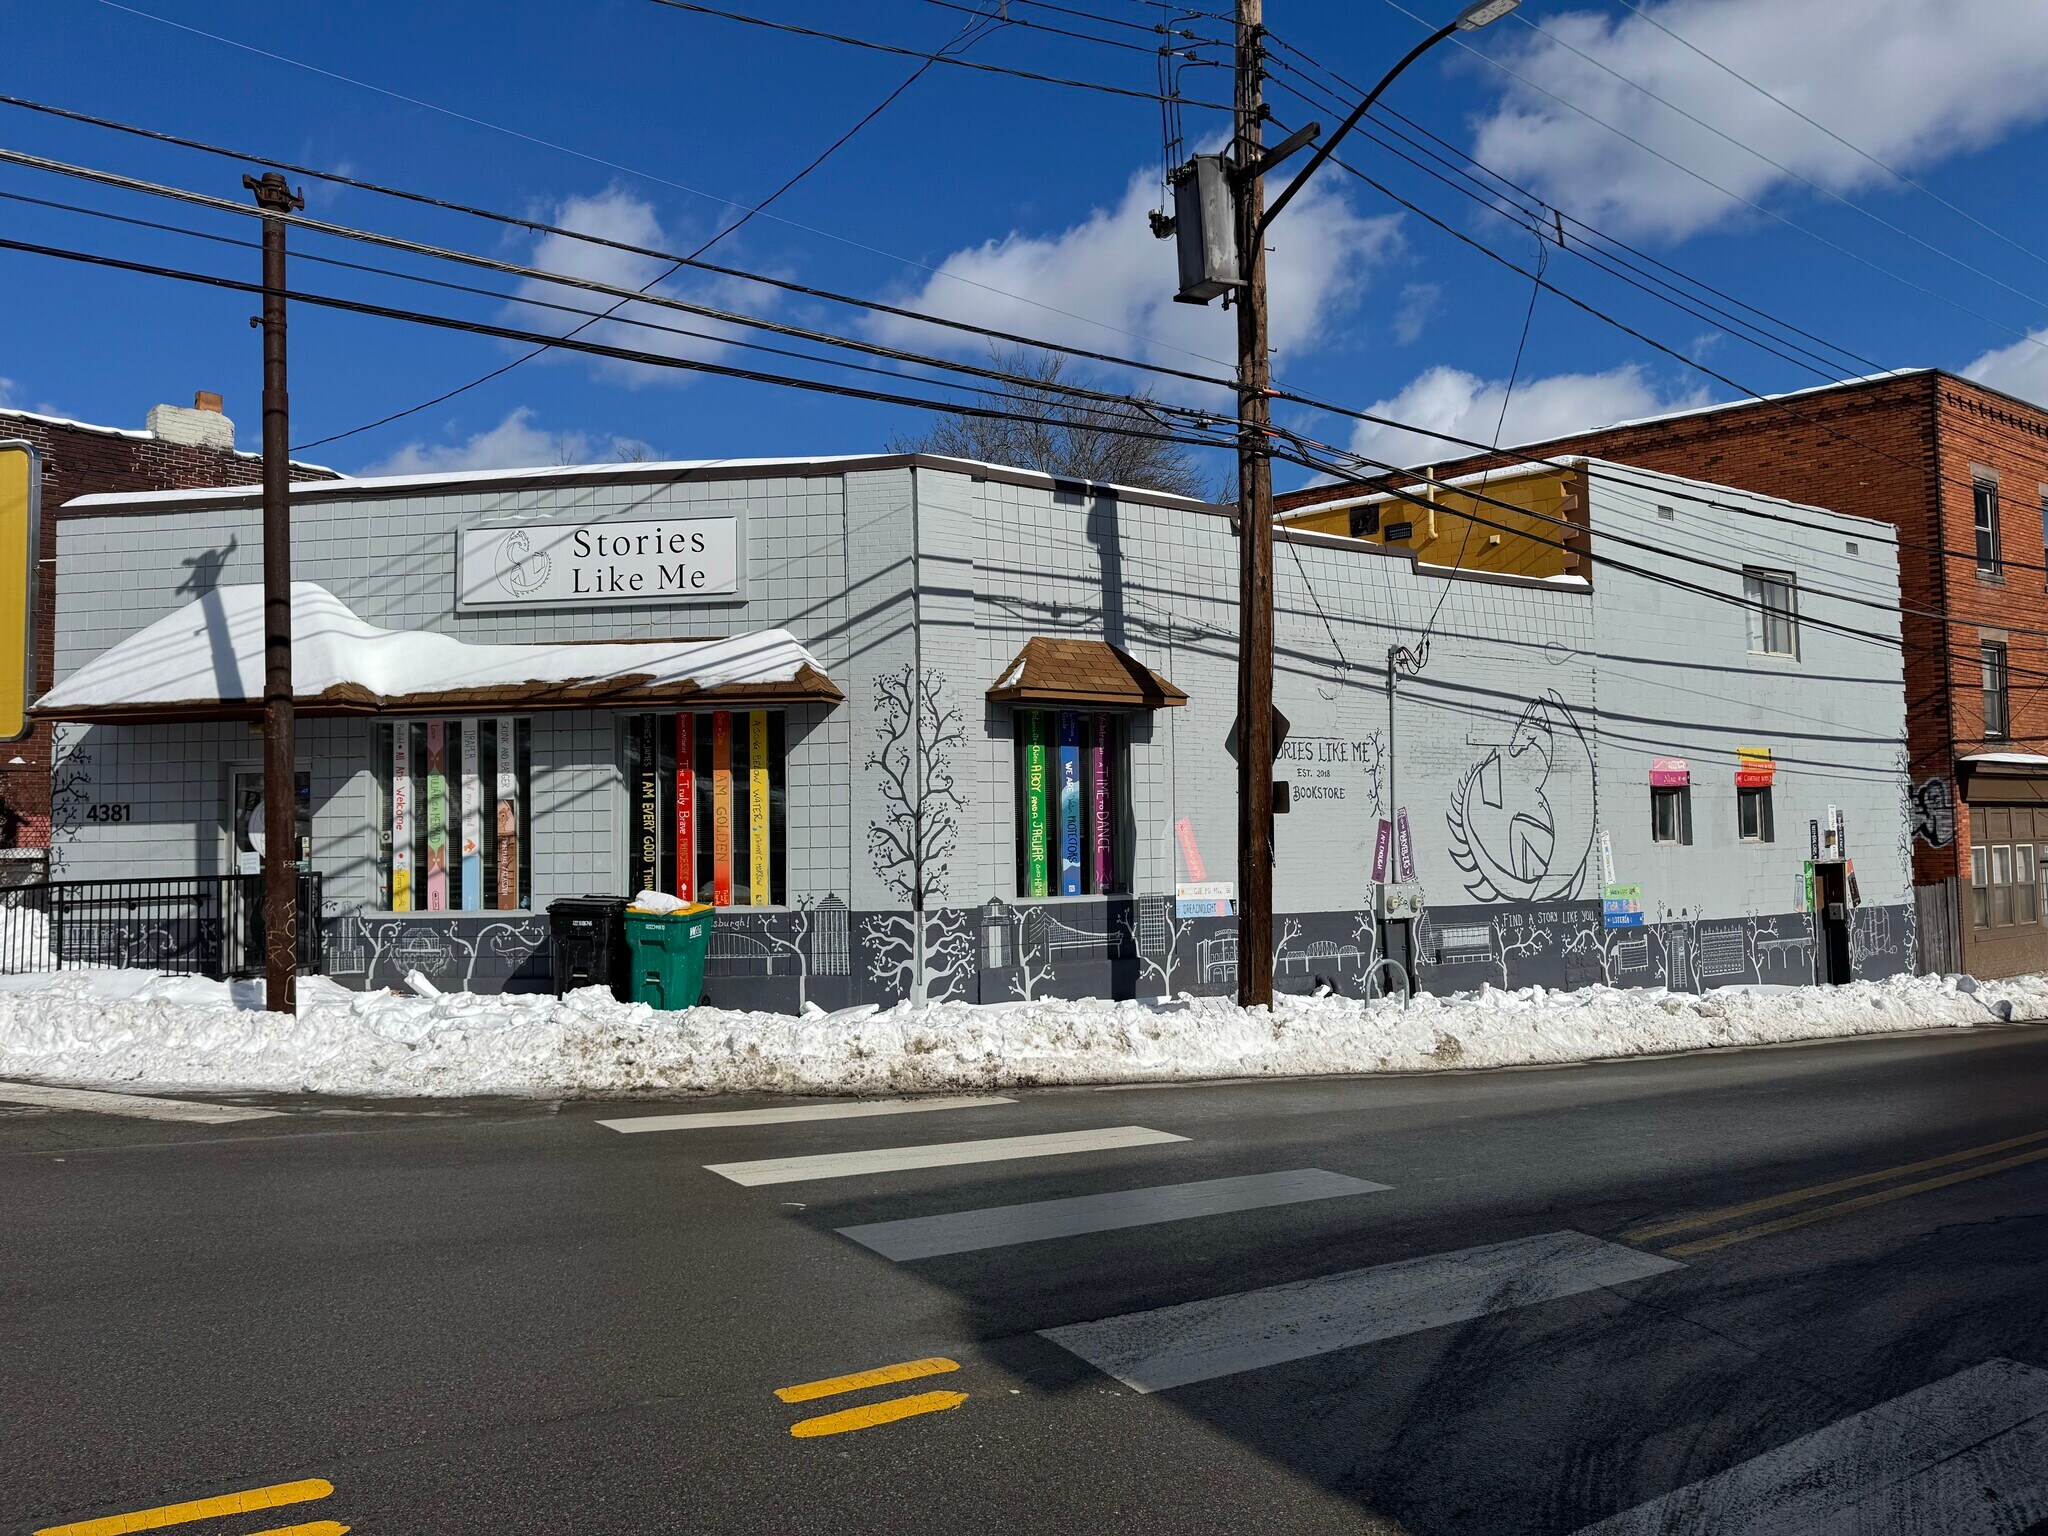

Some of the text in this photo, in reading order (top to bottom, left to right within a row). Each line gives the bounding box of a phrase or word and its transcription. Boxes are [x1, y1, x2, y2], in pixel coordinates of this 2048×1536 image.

[573, 528, 705, 558] Stories
[572, 563, 706, 594] Like Me
[500, 721, 510, 744] SKUNK
[643, 715, 651, 738] BARNES
[464, 730, 476, 760] DRAPER
[500, 747, 510, 759] AND
[643, 744, 651, 767] JAMES
[1031, 745, 1041, 764] Chien
[1318, 742, 1348, 762] LIKE
[1351, 742, 1370, 762] ME
[396, 752, 406, 761] All
[1065, 761, 1073, 774] WE
[396, 766, 406, 781] Are
[465, 769, 475, 783] out
[500, 762, 510, 788] BADGER
[679, 760, 689, 777] The
[753, 754, 763, 784] BELOW
[1297, 768, 1330, 777] EST. 2018
[642, 781, 654, 798] AM
[677, 779, 690, 805] Truly
[715, 774, 727, 796] AM
[1031, 773, 1042, 793] BOY
[1066, 777, 1074, 793] ARE
[1096, 766, 1109, 800] TIME
[1293, 785, 1345, 801] BOOKSTORE
[395, 786, 406, 830] Welcome
[464, 794, 473, 805] my
[753, 789, 763, 822] WATER
[1031, 796, 1039, 811] AND
[1098, 799, 1104, 811] TO
[87, 804, 130, 821] 4381
[465, 809, 475, 827] mind
[642, 803, 654, 832] EVERY
[679, 810, 690, 835] Brave
[430, 813, 441, 844] MERMAID
[716, 807, 728, 862] GOLDEN
[1066, 815, 1077, 863] PROTECTORS
[1096, 811, 1110, 853] DANCE
[1380, 834, 1386, 844] AM
[643, 836, 654, 863] GOOD
[1031, 821, 1044, 862] JAGUAR
[679, 838, 689, 881] PRINCESSES
[643, 866, 654, 890] THIN
[1034, 878, 1043, 896] HMH
[713, 916, 750, 931] sburgh!
[1502, 910, 1597, 927] FIND A STORY LIKE YOU.
